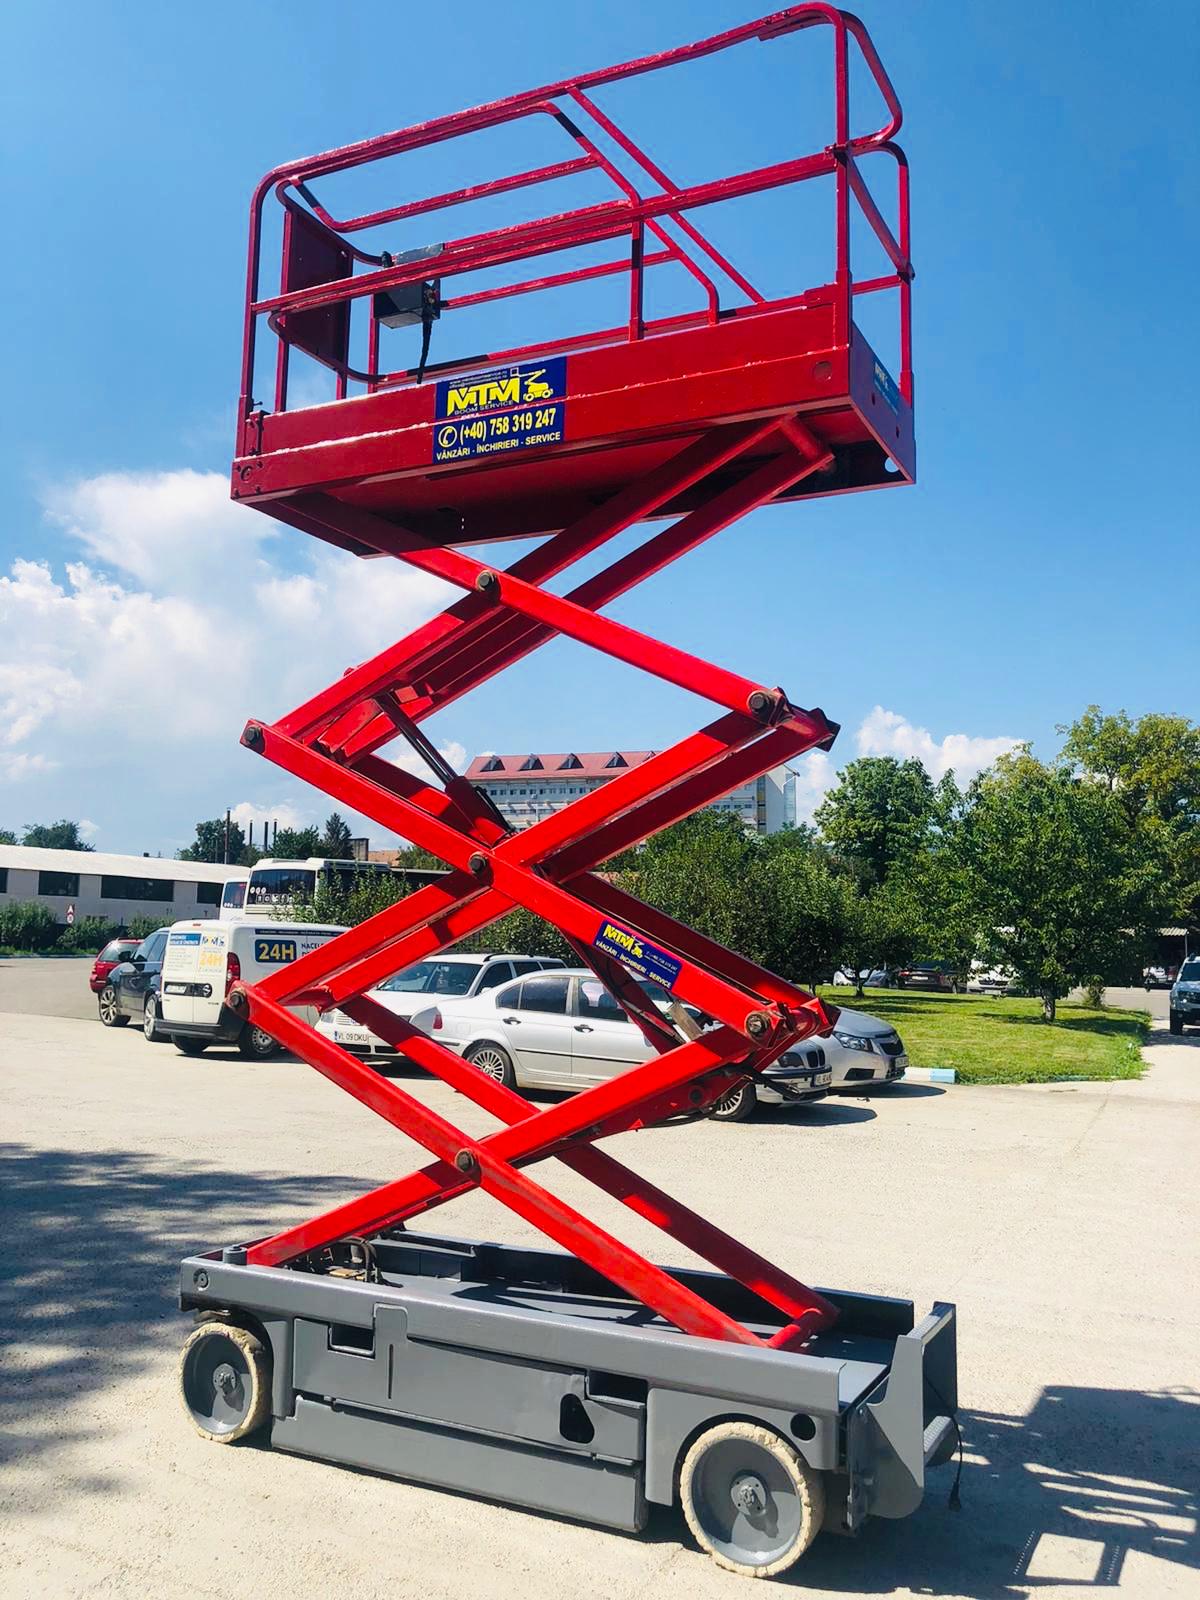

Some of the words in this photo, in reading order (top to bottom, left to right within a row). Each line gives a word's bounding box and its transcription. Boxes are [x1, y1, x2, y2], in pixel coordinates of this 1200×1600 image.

[454, 406, 478, 416] BOOM
[460, 421, 487, 445] (+40)
[490, 416, 510, 436] 758
[512, 412, 533, 434] 319
[535, 408, 557, 429] 247
[525, 431, 561, 446] SERVICE
[258, 943, 295, 960] 24H
[301, 942, 324, 950] NACEL
[648, 971, 672, 989] SERVICE
